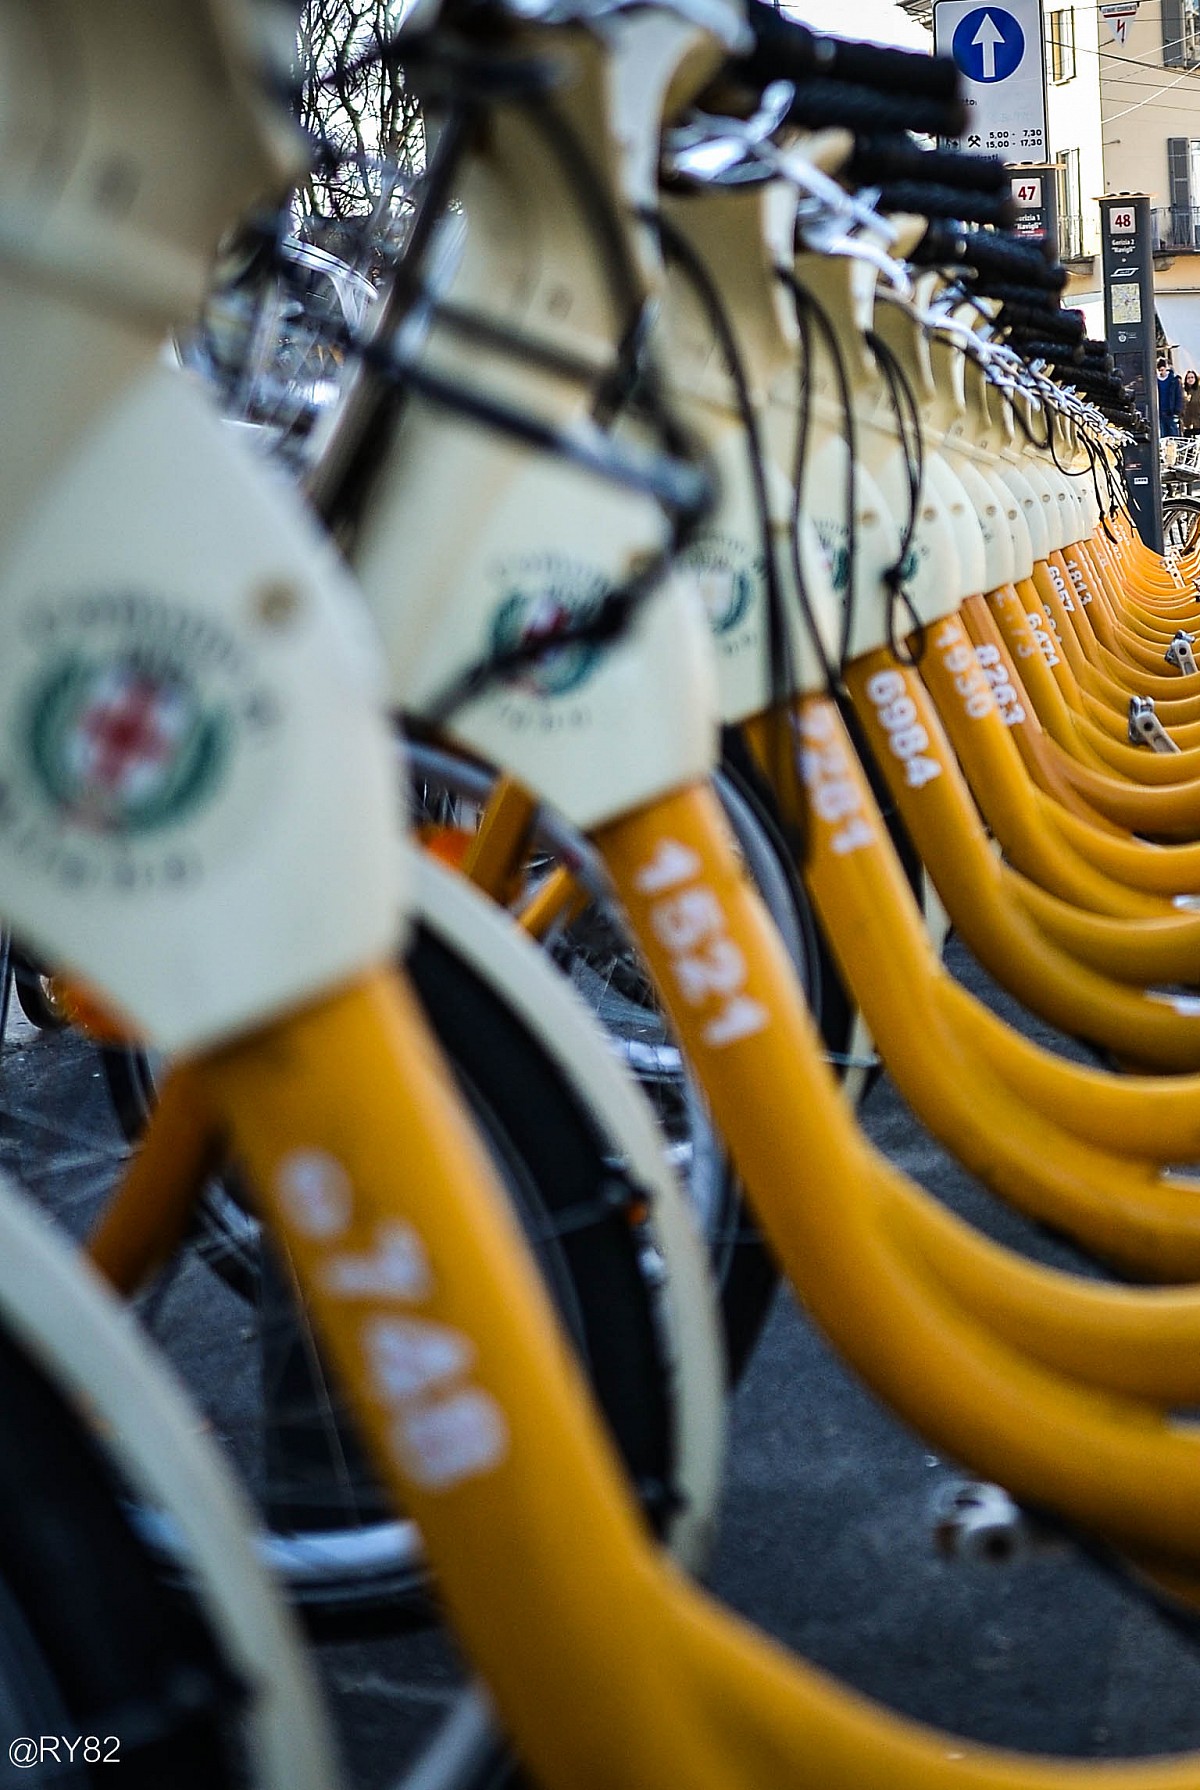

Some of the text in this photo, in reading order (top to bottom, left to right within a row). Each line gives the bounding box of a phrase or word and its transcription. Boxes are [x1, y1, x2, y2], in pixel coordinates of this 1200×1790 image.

[1018, 186, 1036, 200] 47
[1115, 214, 1131, 227] 48
[1067, 560, 1093, 605] 1813
[868, 668, 942, 787] 6984
[635, 838, 770, 1044] 1521
